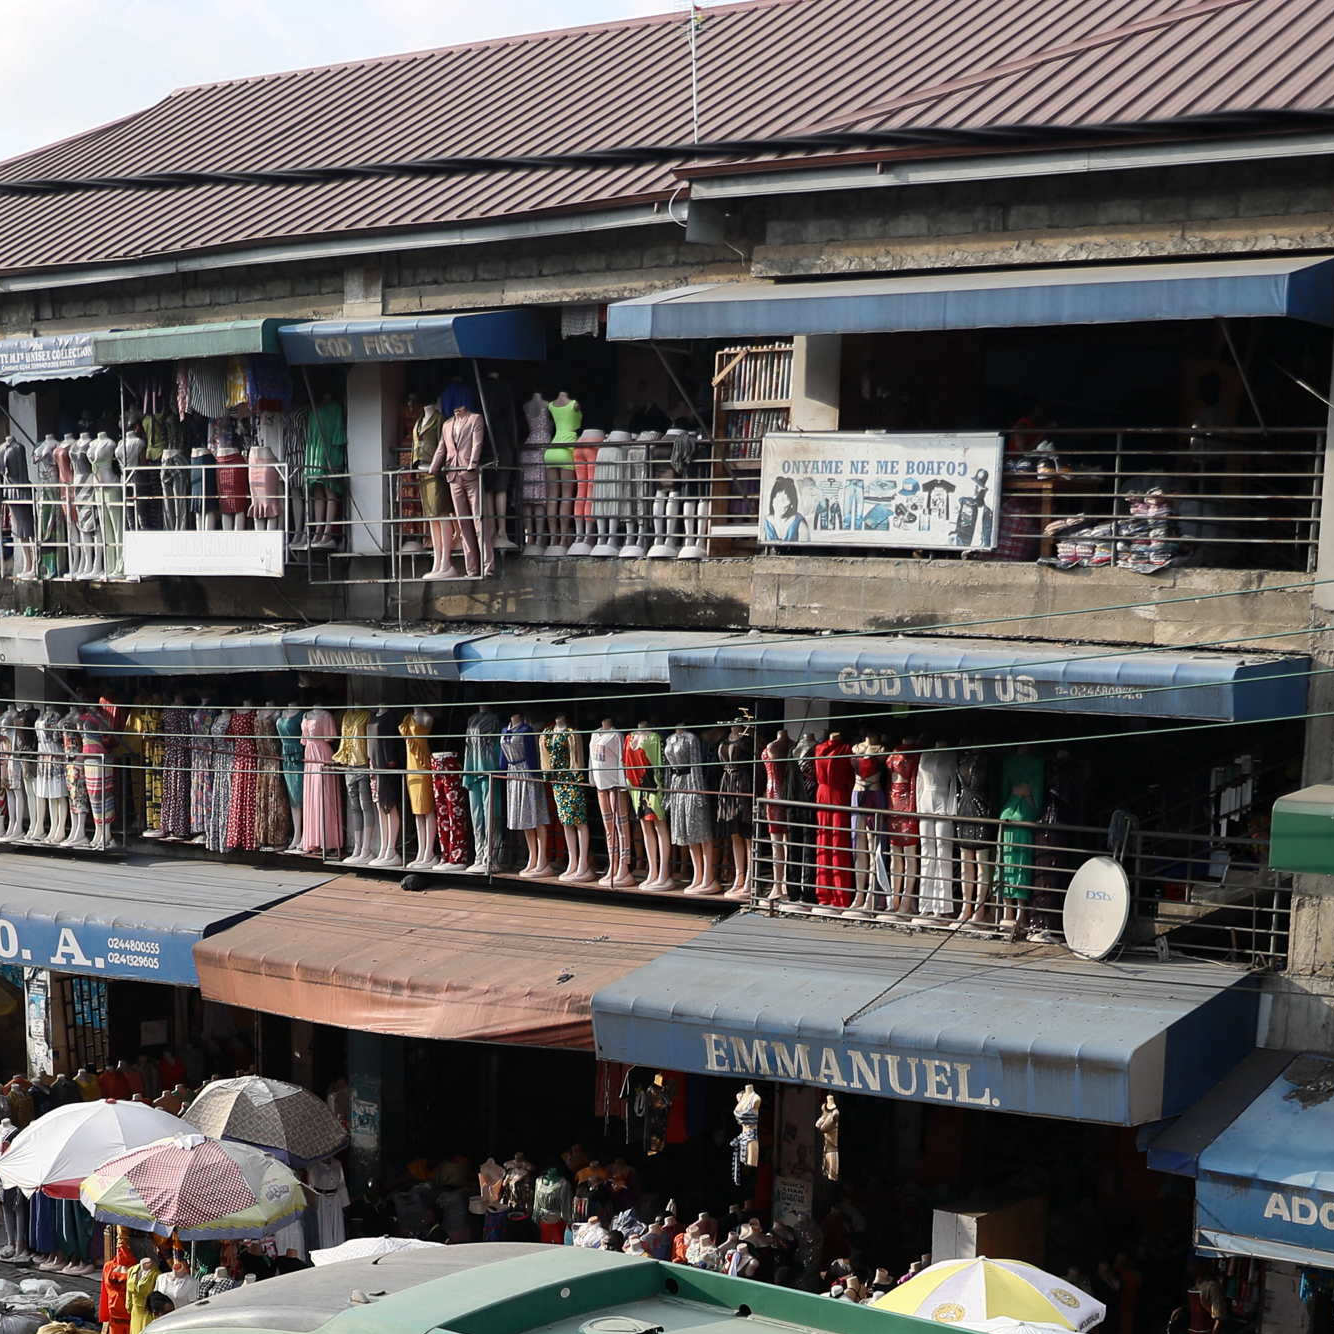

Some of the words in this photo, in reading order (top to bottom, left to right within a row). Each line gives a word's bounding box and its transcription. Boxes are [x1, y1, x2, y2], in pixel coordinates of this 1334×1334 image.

[314, 337, 352, 358] GOD
[362, 333, 415, 356] FIRST
[25, 350, 50, 362] UNISEX
[782, 460, 843, 475] ONYAME
[849, 460, 869, 475] NE
[876, 460, 899, 475] ME
[838, 666, 902, 696] GOD
[909, 669, 984, 702] WITH
[995, 674, 1039, 703] US
[1086, 891, 1116, 902] DStv
[50, 927, 105, 969] A.
[107, 937, 160, 954] 0244800555
[107, 952, 159, 970] 0241329605
[781, 1181, 805, 1190] QUICK
[783, 1187, 803, 1195] LOAN
